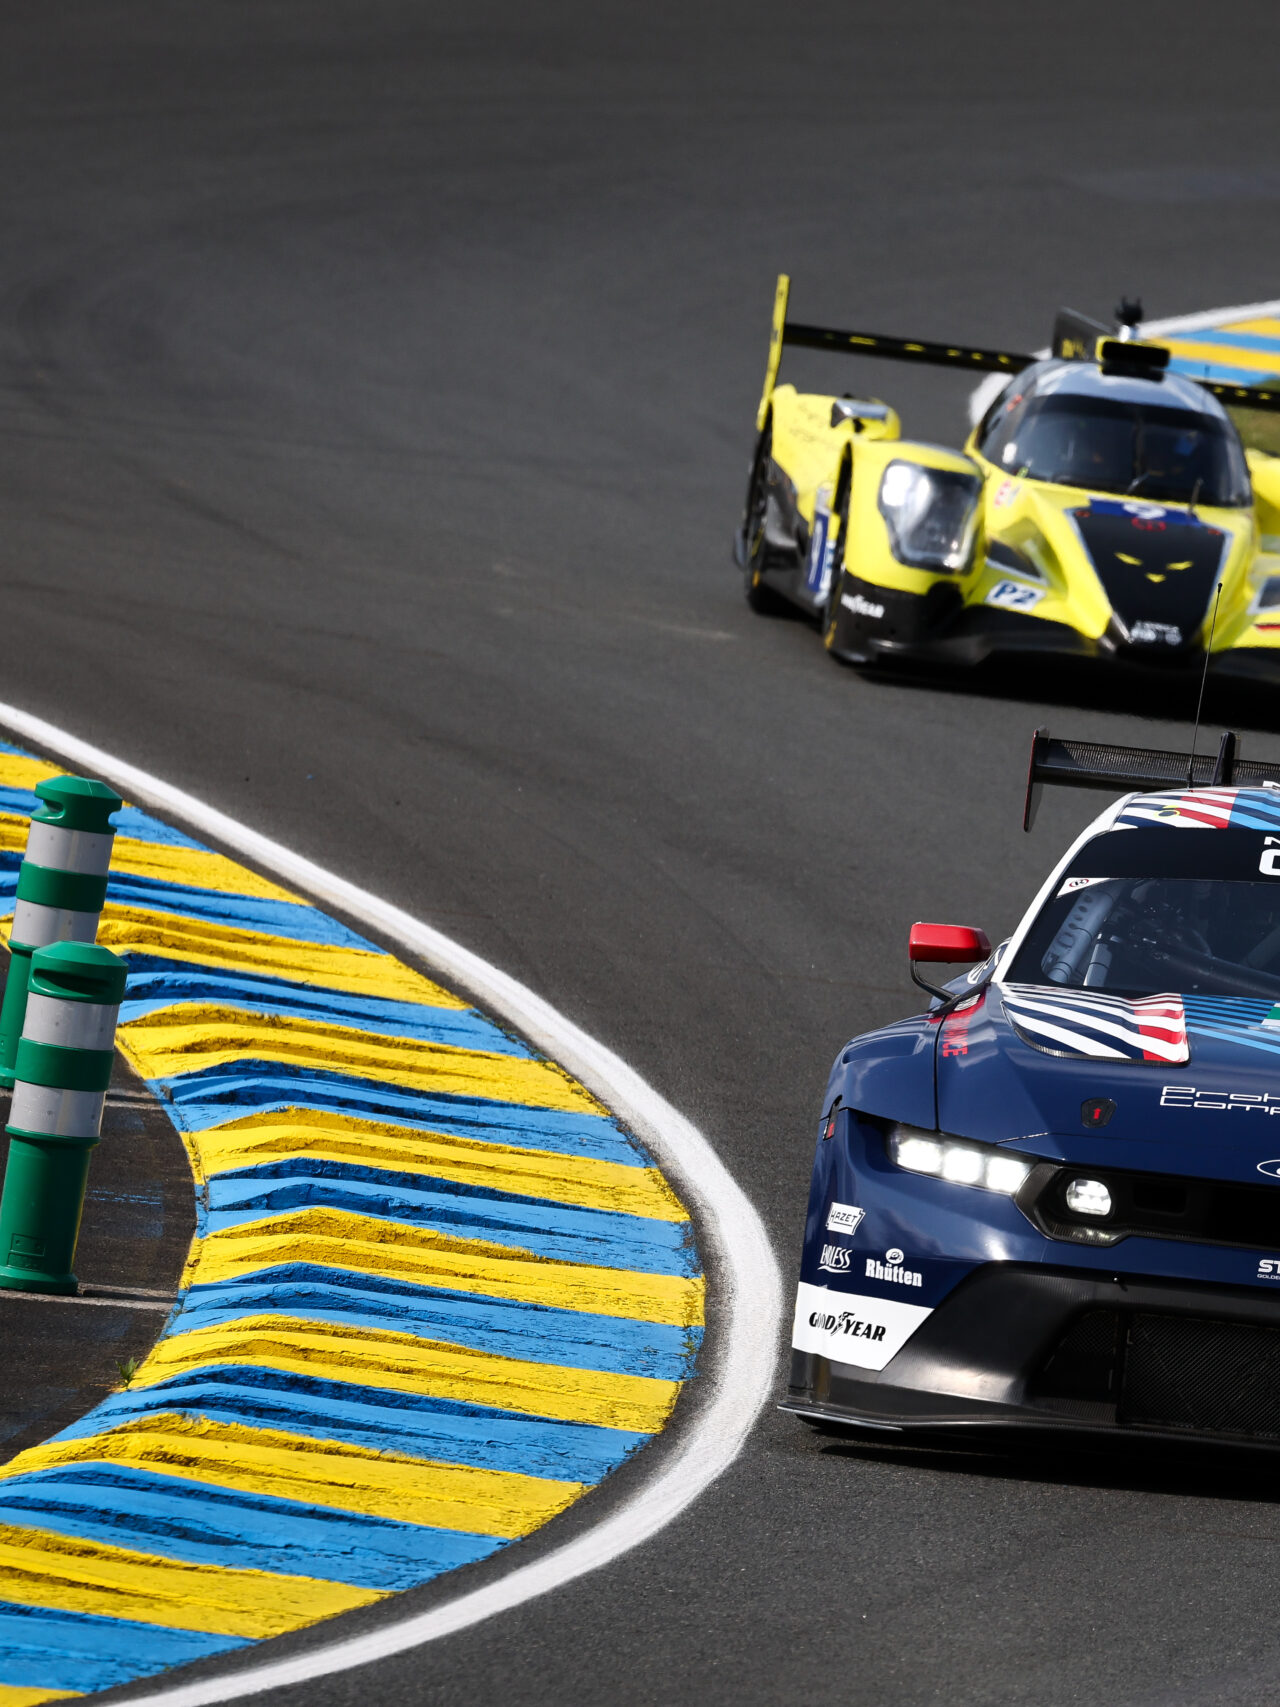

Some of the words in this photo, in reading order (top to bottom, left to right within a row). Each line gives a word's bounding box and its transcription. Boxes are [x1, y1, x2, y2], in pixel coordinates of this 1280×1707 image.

[994, 583, 1036, 604] P2
[830, 1210, 858, 1223] HAZET
[865, 1258, 923, 1287] Rhütten
[808, 1312, 887, 1342] GOODYEAR
